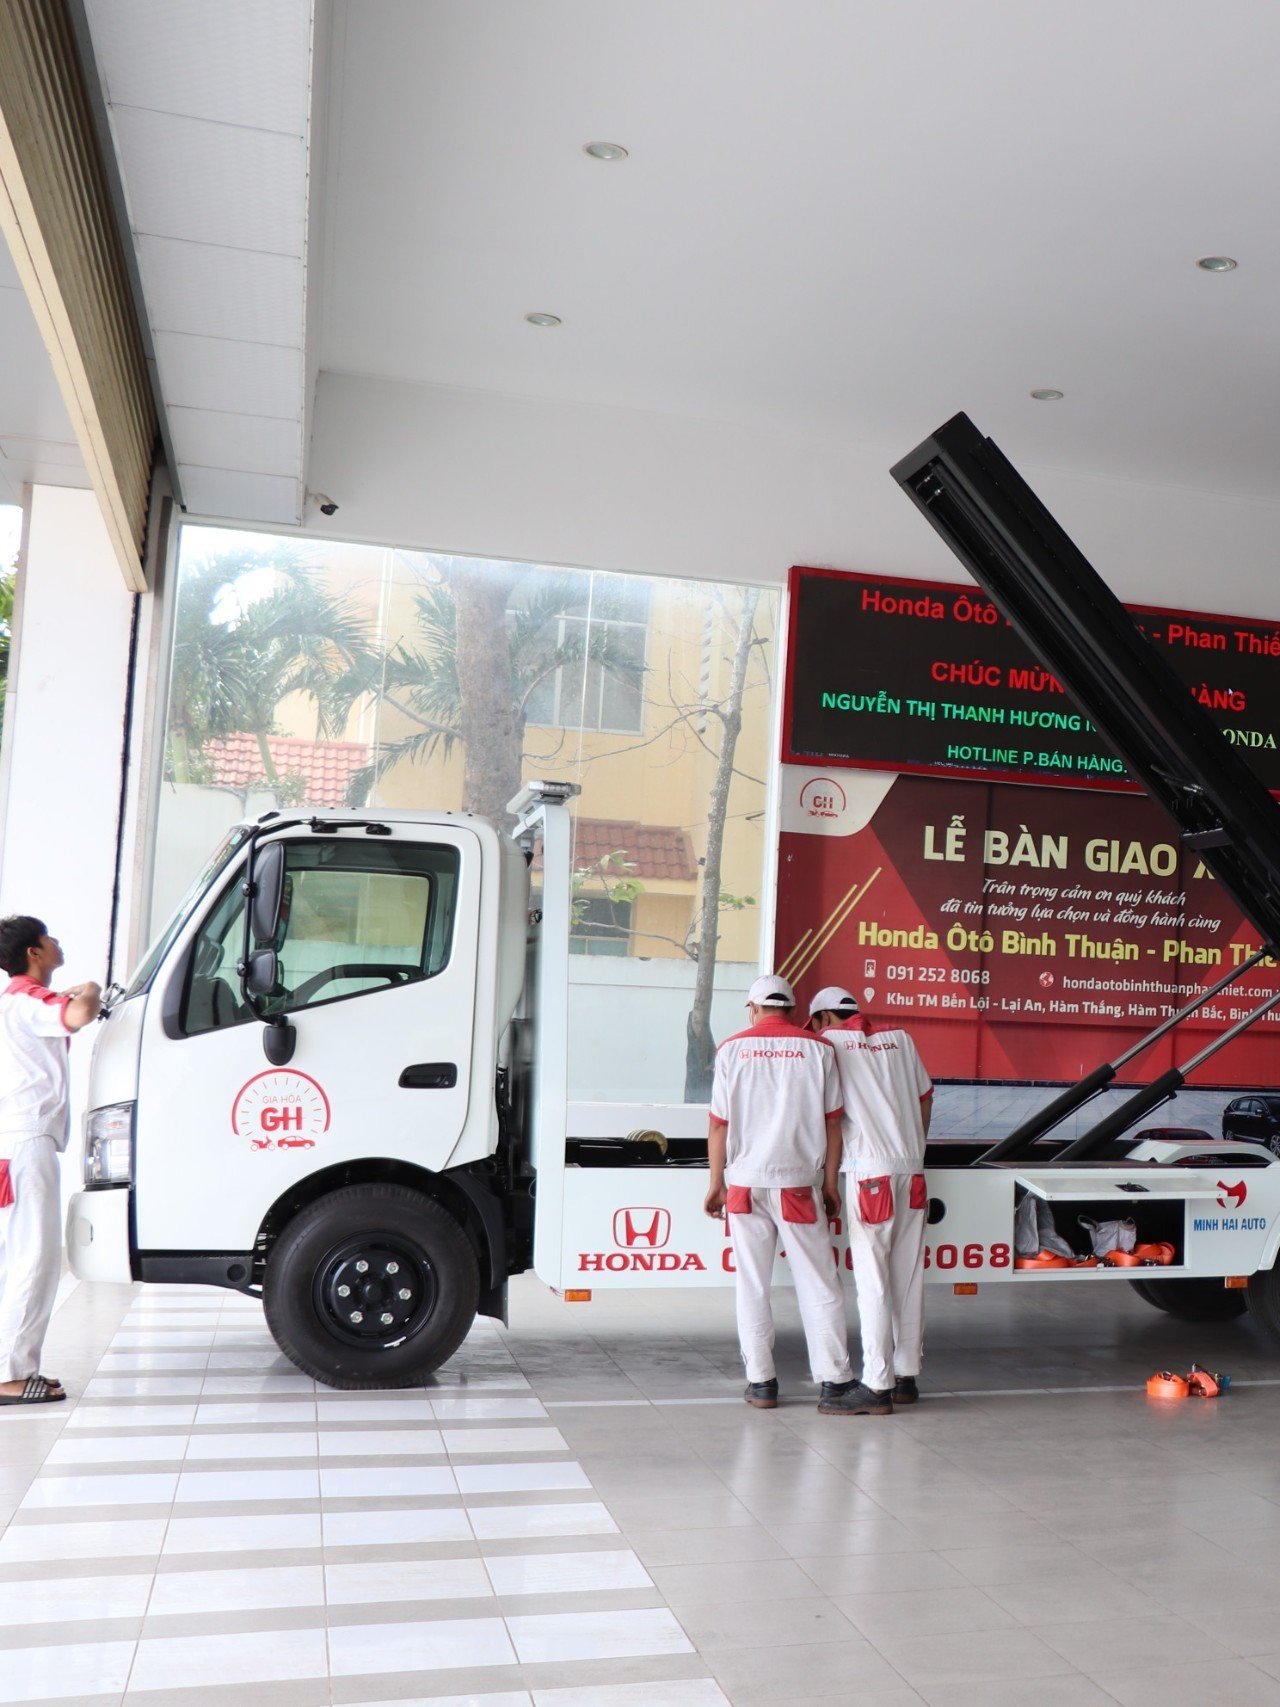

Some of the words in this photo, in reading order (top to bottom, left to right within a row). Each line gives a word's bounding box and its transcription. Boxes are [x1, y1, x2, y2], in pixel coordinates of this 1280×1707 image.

[861, 588, 944, 619] Honda
[953, 594, 998, 625] Ôtô
[1168, 624, 1226, 650] Phan
[931, 660, 1001, 687] CHÚC
[1009, 665, 1065, 693] MỪN
[1191, 683, 1246, 711] ÀNG
[821, 690, 900, 715] NGUYỄN
[907, 699, 936, 721] THỊ
[941, 703, 1004, 724] THANH
[1010, 710, 1081, 731] HƯƠNG
[1220, 728, 1277, 750] ONDA
[947, 745, 1018, 764] HOTLINE
[1023, 751, 1072, 769] P.BÁN
[924, 814, 967, 862] LỄ
[984, 824, 1068, 869] BÀN
[1085, 839, 1178, 877] GIAO
[982, 878, 1016, 895] Trân
[1019, 883, 1058, 902] trọng
[1061, 884, 1092, 900] cảm
[1095, 889, 1112, 902] ơn
[1115, 890, 1142, 906] quý
[1145, 890, 1186, 906] khách
[940, 898, 960, 913] đã
[964, 901, 983, 914] tin
[986, 901, 1027, 920] tưởng
[1030, 904, 1052, 920] lựa
[1056, 907, 1089, 922] chọn
[1092, 908, 1111, 922] và
[1114, 909, 1148, 929] đồng
[1150, 911, 1185, 928] hành
[1187, 914, 1220, 933] cùng
[858, 921, 939, 950] Honda
[946, 922, 994, 953] Ôtô
[1002, 930, 1057, 956] Bình
[1065, 934, 1140, 965] Thuận
[1163, 939, 1221, 965] Phan
[886, 965, 914, 981] 091
[918, 967, 946, 982] 252
[950, 968, 990, 985] 8068
[886, 992, 914, 1006] Khu
[917, 994, 938, 1007] TM
[969, 996, 990, 1012] Lội
[1001, 997, 1023, 1013] Lại
[1024, 1000, 1046, 1013] An,
[1050, 1000, 1078, 1014] Hàm
[1082, 999, 1125, 1018] Thắng,
[1128, 1003, 1157, 1017] Hàm
[1202, 1005, 1226, 1021] Bắc,
[1230, 1008, 1253, 1020] Bìn
[753, 1050, 806, 1059] HONDA
[261, 1106, 302, 1131] GH
[1194, 1219, 1219, 1231] MINH
[1222, 1218, 1238, 1231] HAI
[1241, 1217, 1266, 1230] AUTO
[577, 1253, 708, 1271] HONDA
